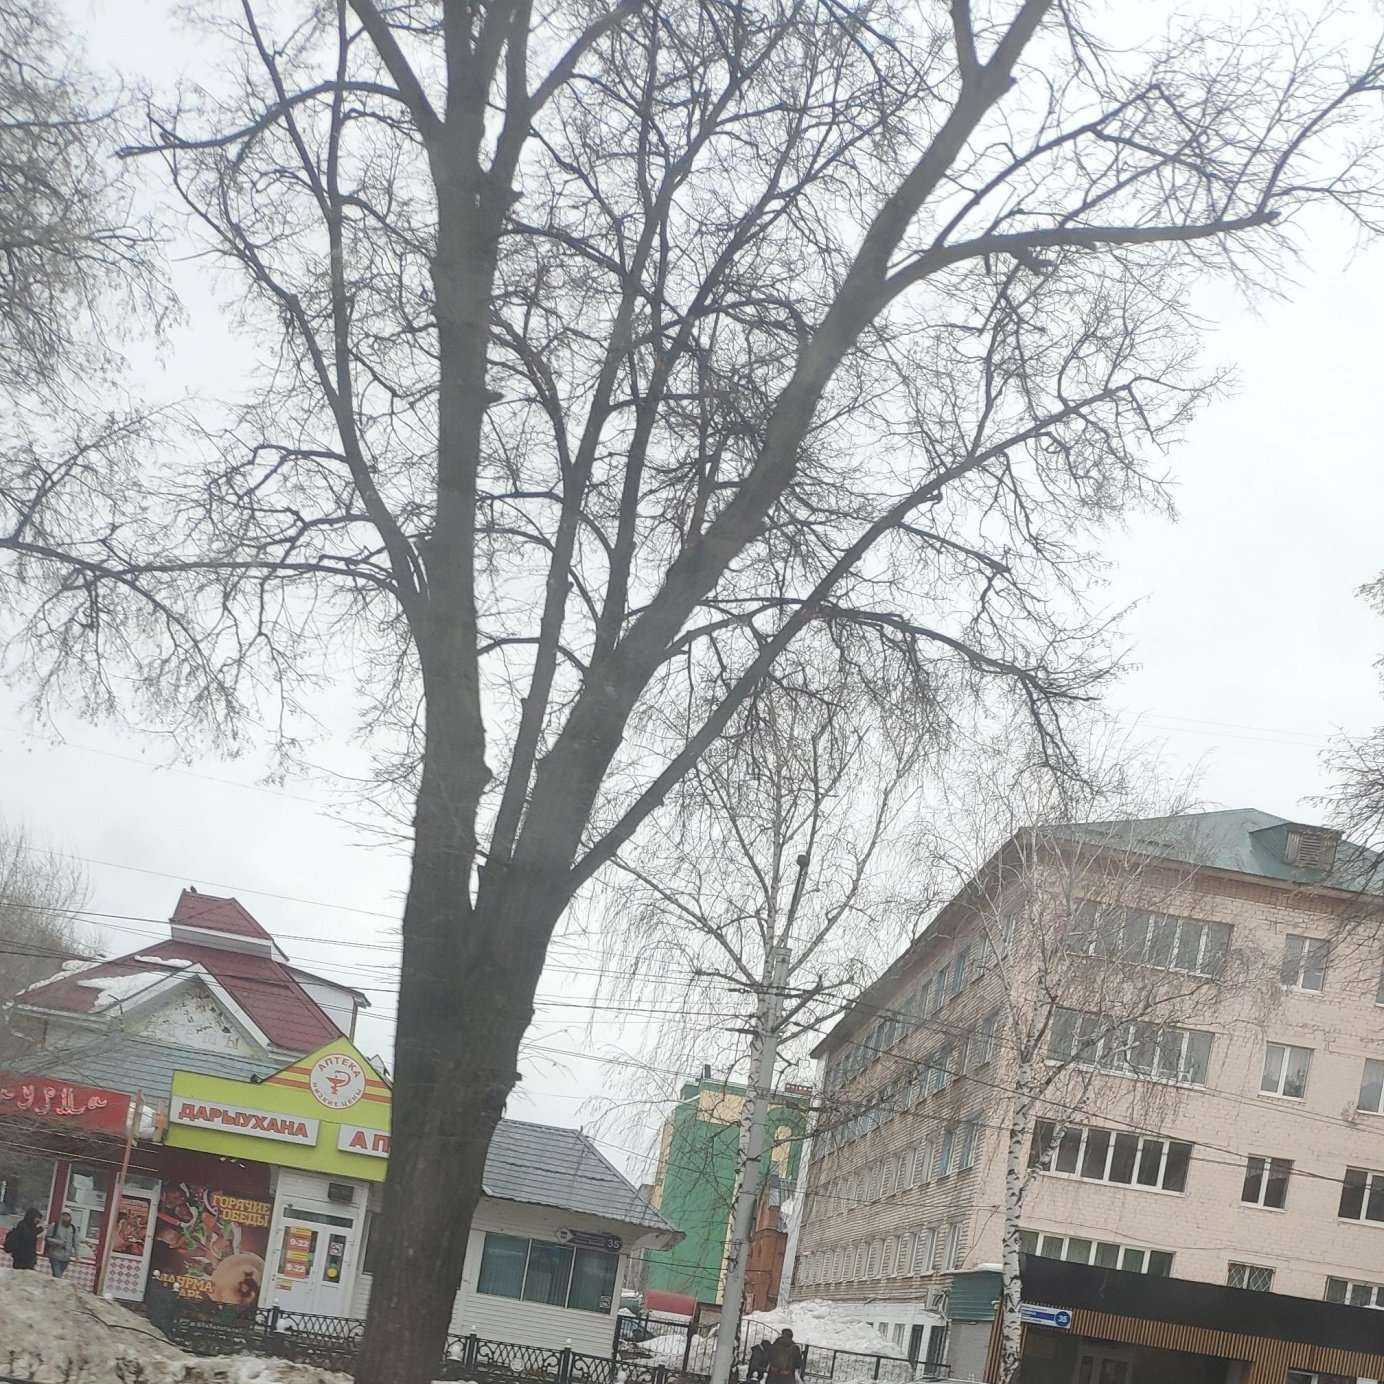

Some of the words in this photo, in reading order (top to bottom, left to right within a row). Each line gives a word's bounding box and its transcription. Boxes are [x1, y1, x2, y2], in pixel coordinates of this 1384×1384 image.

[318, 1056, 361, 1078] АПТЕКА
[178, 1103, 308, 1138] ДАРЫУХАНА
[349, 1130, 391, 1158] АП
[213, 1195, 272, 1214] ГОРЯЧИЕ
[222, 1208, 269, 1227] ОБЕДЫ
[607, 1239, 620, 1249] 35
